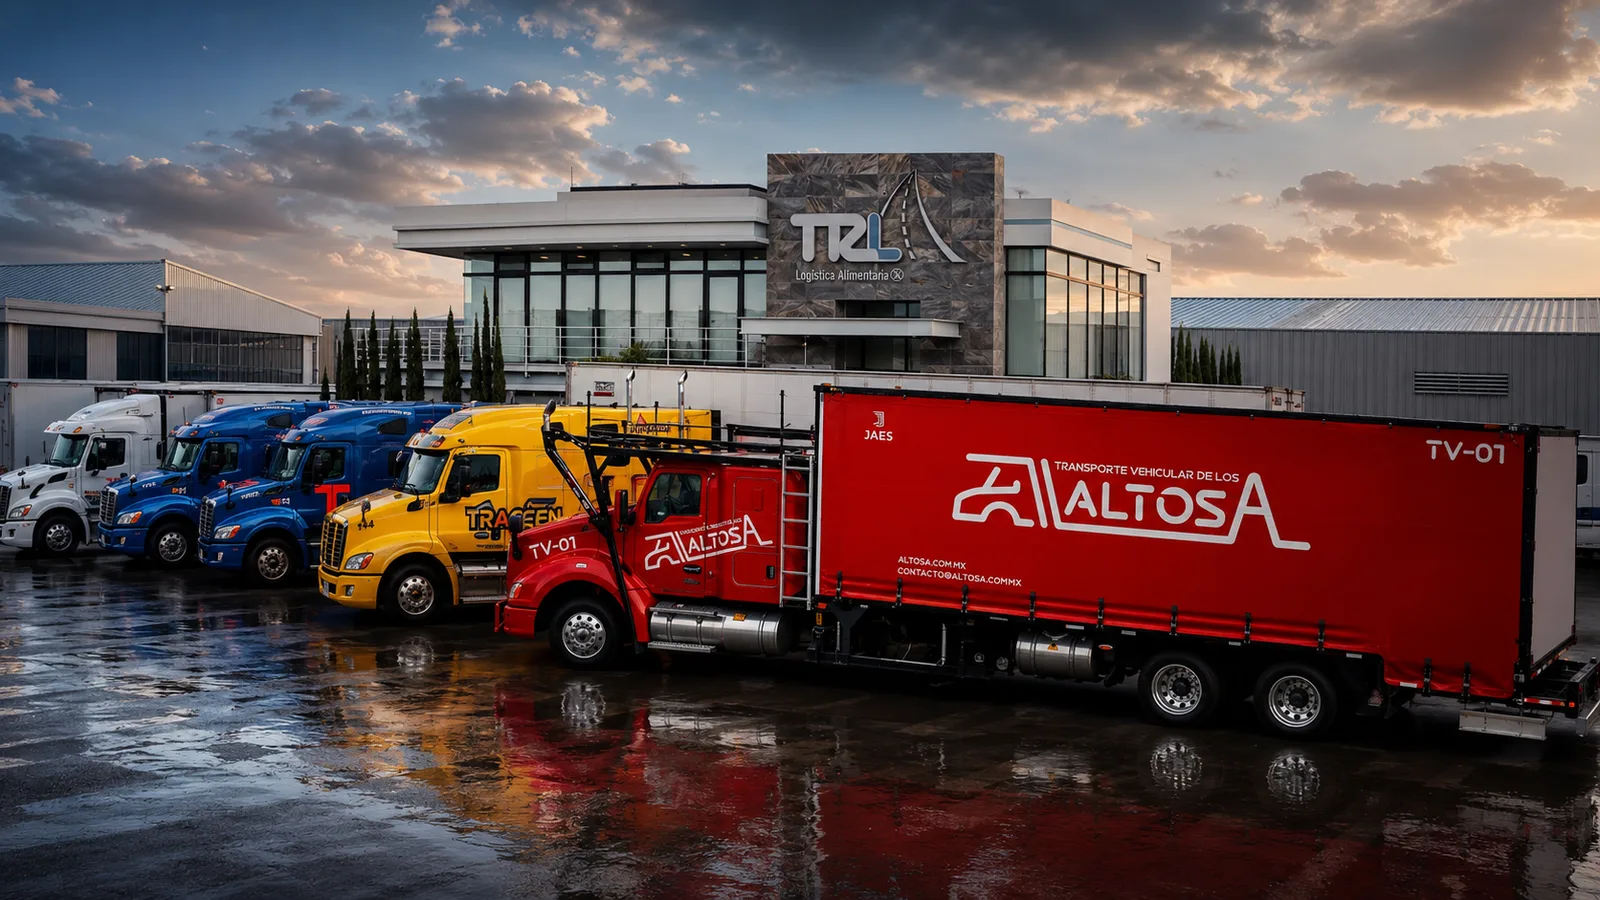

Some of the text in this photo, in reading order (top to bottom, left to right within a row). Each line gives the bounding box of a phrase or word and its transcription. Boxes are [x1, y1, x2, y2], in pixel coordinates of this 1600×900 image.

[790, 213, 902, 262] TRL
[838, 269, 889, 281] Alimentaria
[864, 430, 893, 441] JAES
[1426, 439, 1505, 464] TV-01
[1054, 461, 1240, 483] TRANSPORTE VEHICULAR DE LOS
[1064, 472, 1311, 550] ALTOSA
[687, 514, 773, 555] ALTOSA
[528, 536, 577, 559] TV-01
